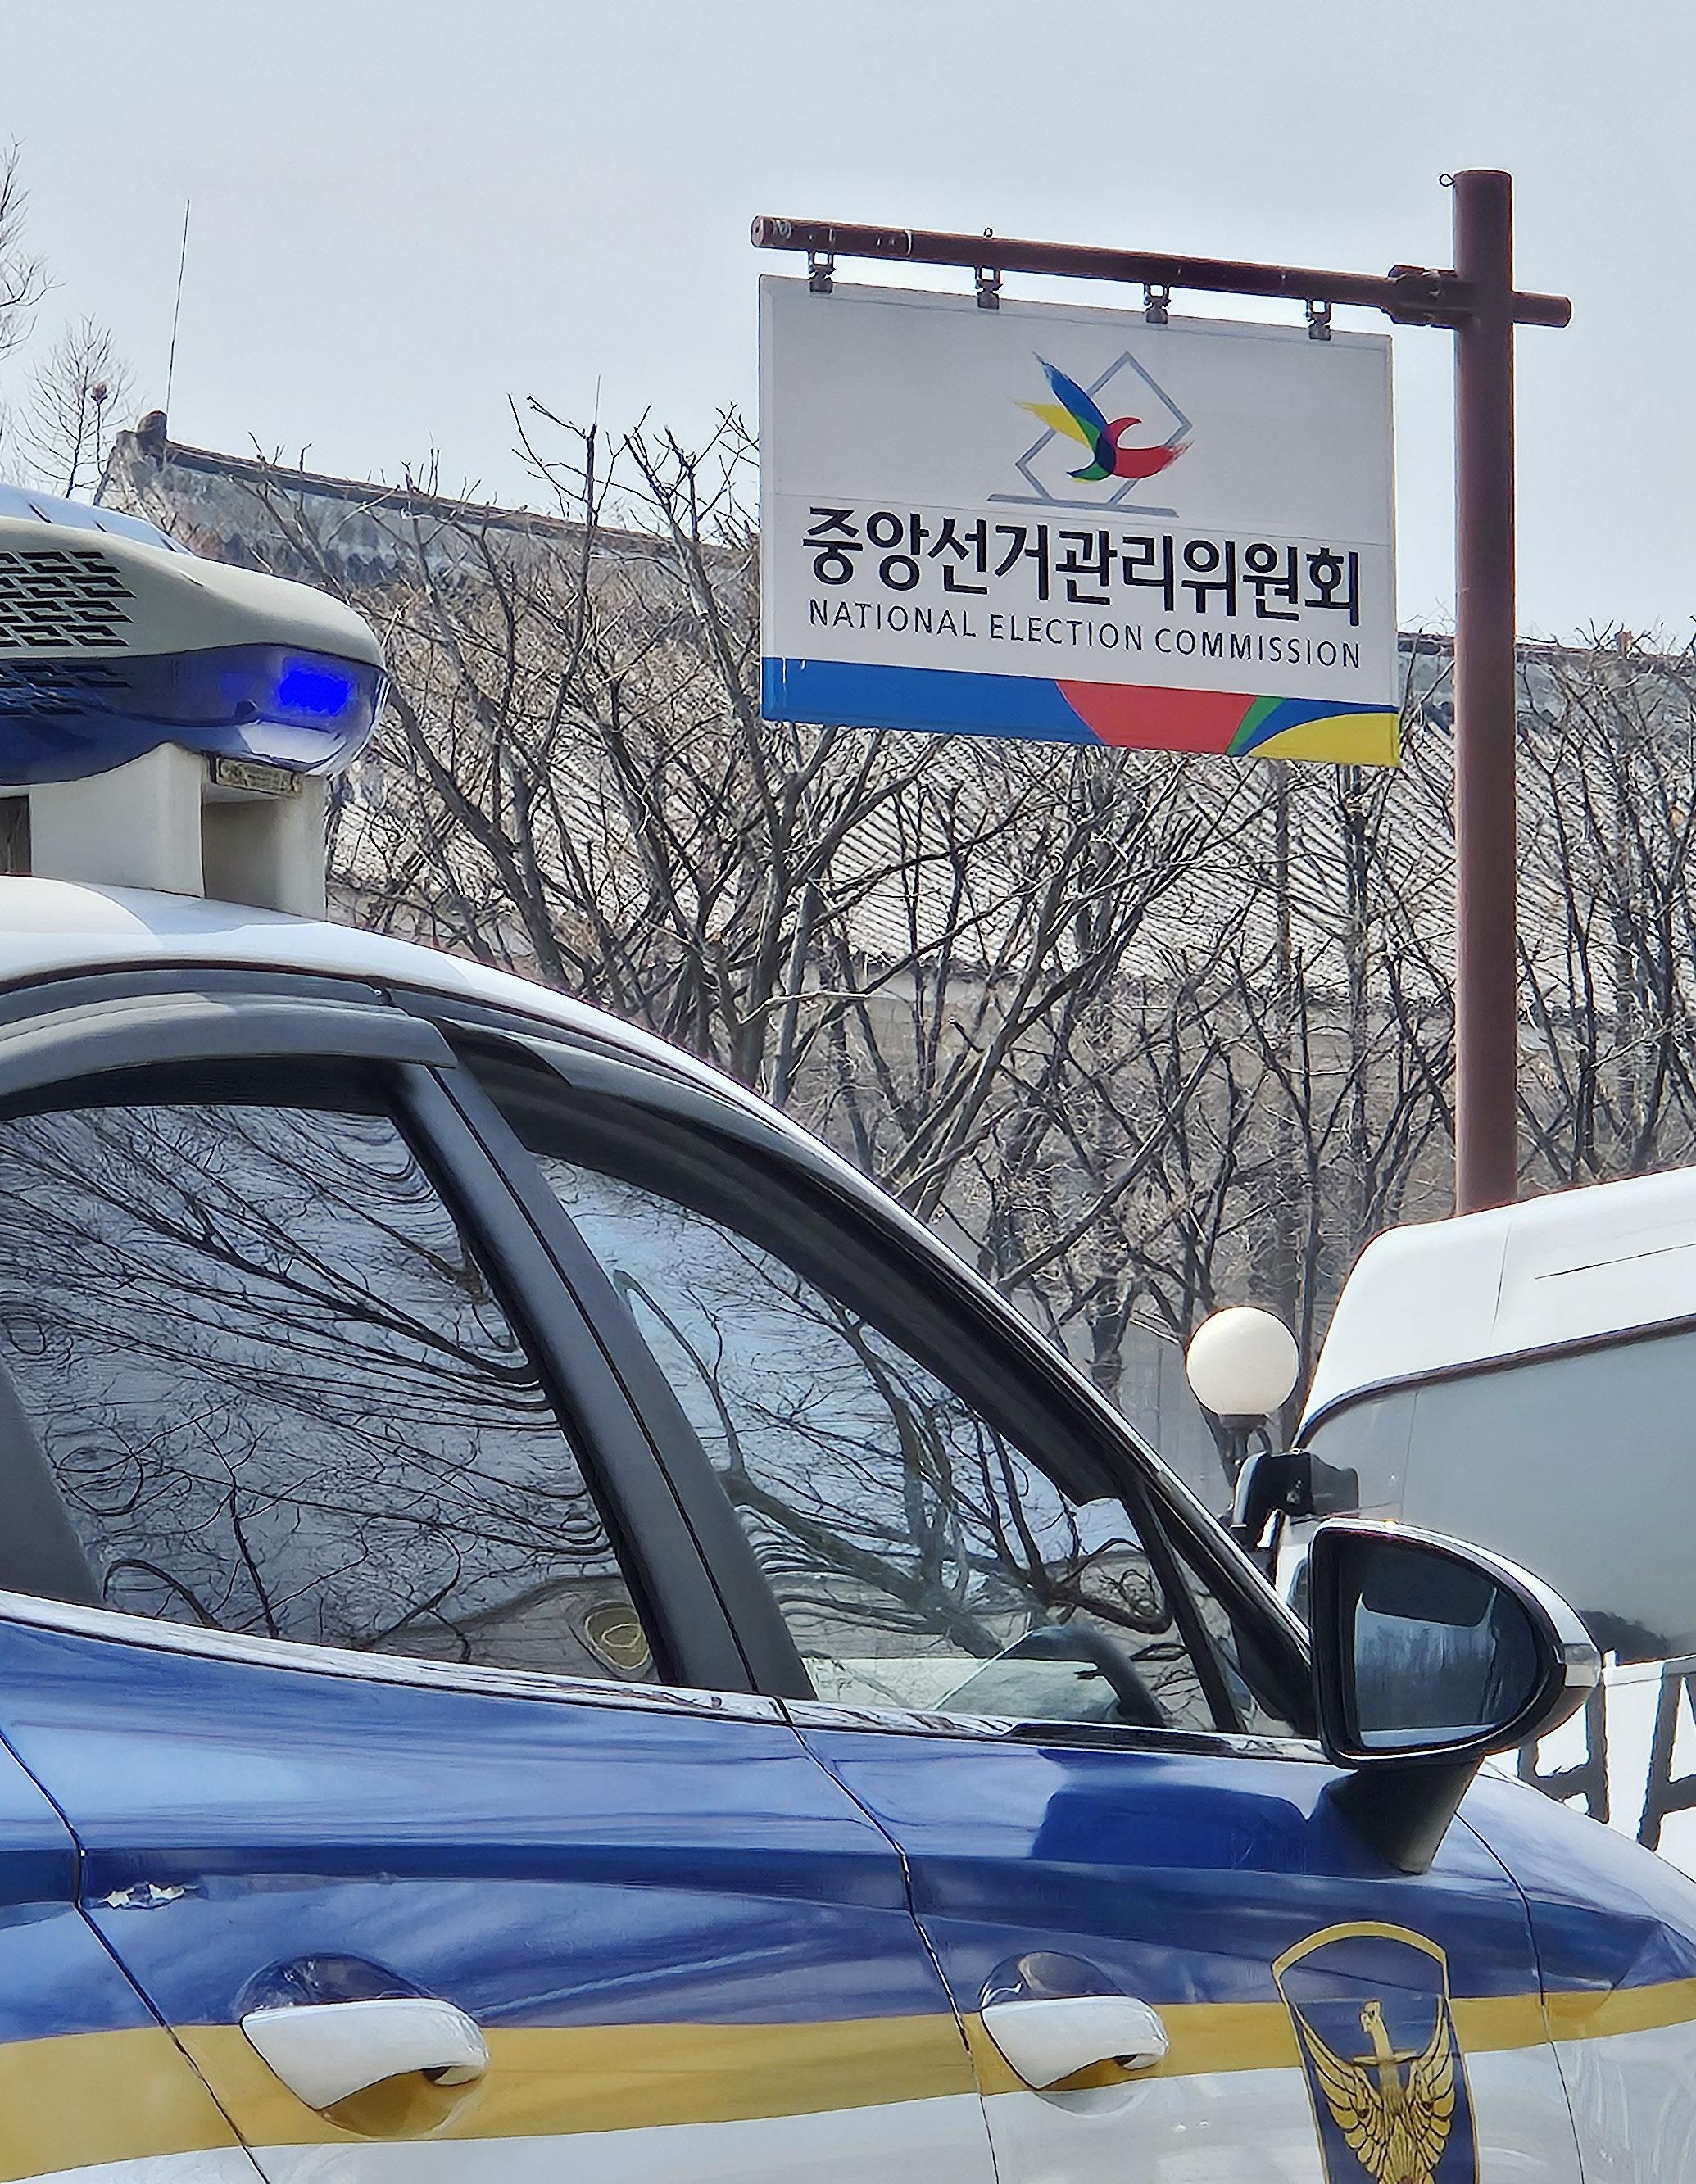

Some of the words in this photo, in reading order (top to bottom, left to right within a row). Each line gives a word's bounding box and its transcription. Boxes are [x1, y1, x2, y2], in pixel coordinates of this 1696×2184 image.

[802, 506, 1360, 627] 중앙선거관리위원회
[809, 598, 977, 637] NATIONAL
[989, 613, 1142, 651] ELECTION
[1154, 628, 1359, 668] COMMISSION
